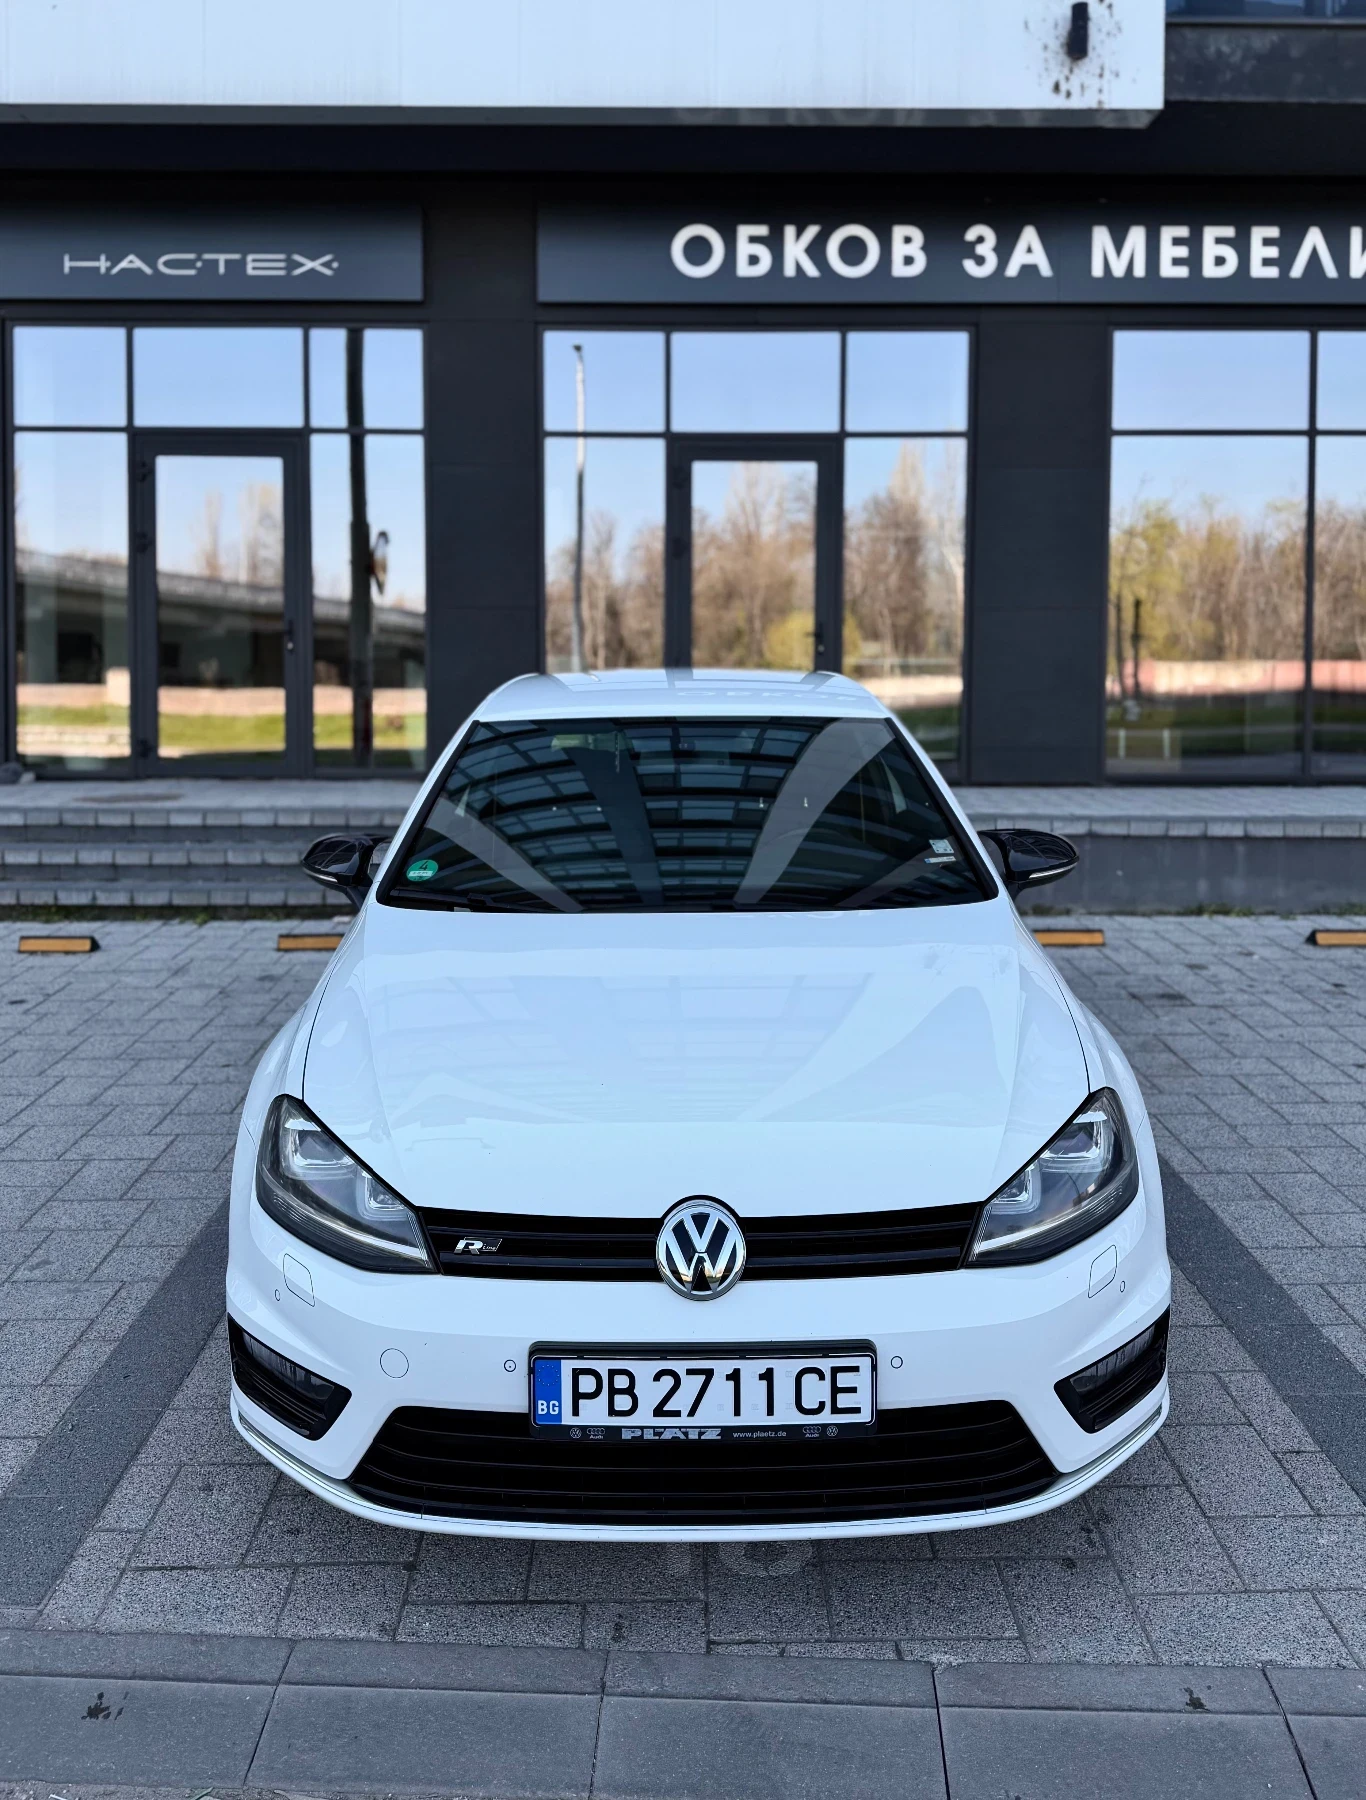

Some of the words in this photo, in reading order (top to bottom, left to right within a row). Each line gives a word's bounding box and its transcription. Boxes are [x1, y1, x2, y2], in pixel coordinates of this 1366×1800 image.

[670, 223, 928, 279] ОБКОВ
[961, 223, 1054, 279] ЗА
[419, 860, 429, 870] 4
[652, 1367, 775, 1417] 2711
[537, 1401, 559, 1414] BG
[732, 1430, 787, 1438] www.plaetz.de
